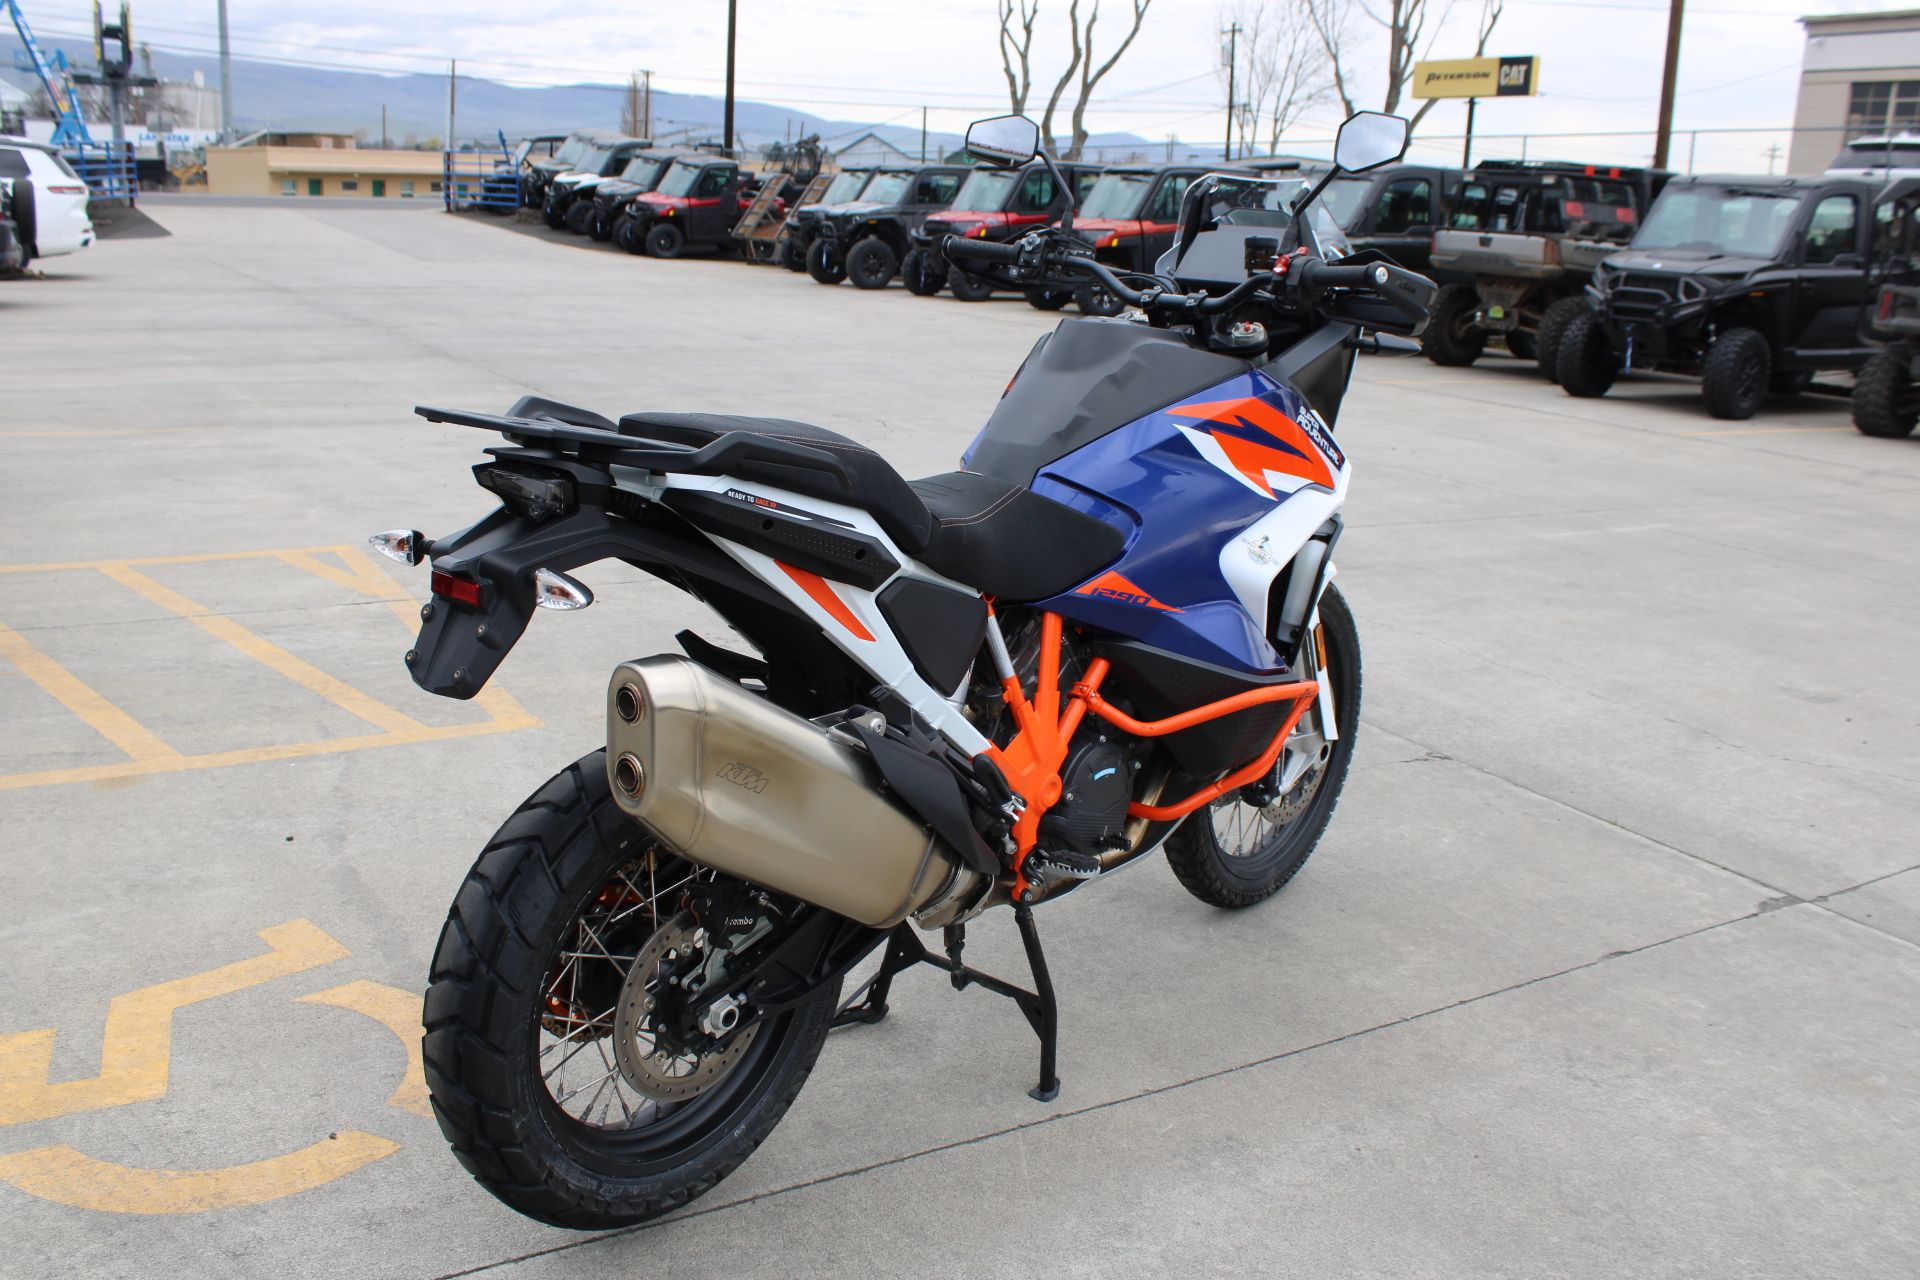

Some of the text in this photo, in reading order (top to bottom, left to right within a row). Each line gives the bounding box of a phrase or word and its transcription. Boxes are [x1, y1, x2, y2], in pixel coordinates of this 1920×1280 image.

[1500, 64, 1528, 85] CAT
[1299, 406, 1320, 431] SUPER
[1296, 414, 1339, 466] ADVENTURE
[727, 490, 746, 501] READY
[747, 495, 755, 503] TO
[1089, 588, 1152, 607] 1290
[716, 762, 770, 794] KTM
